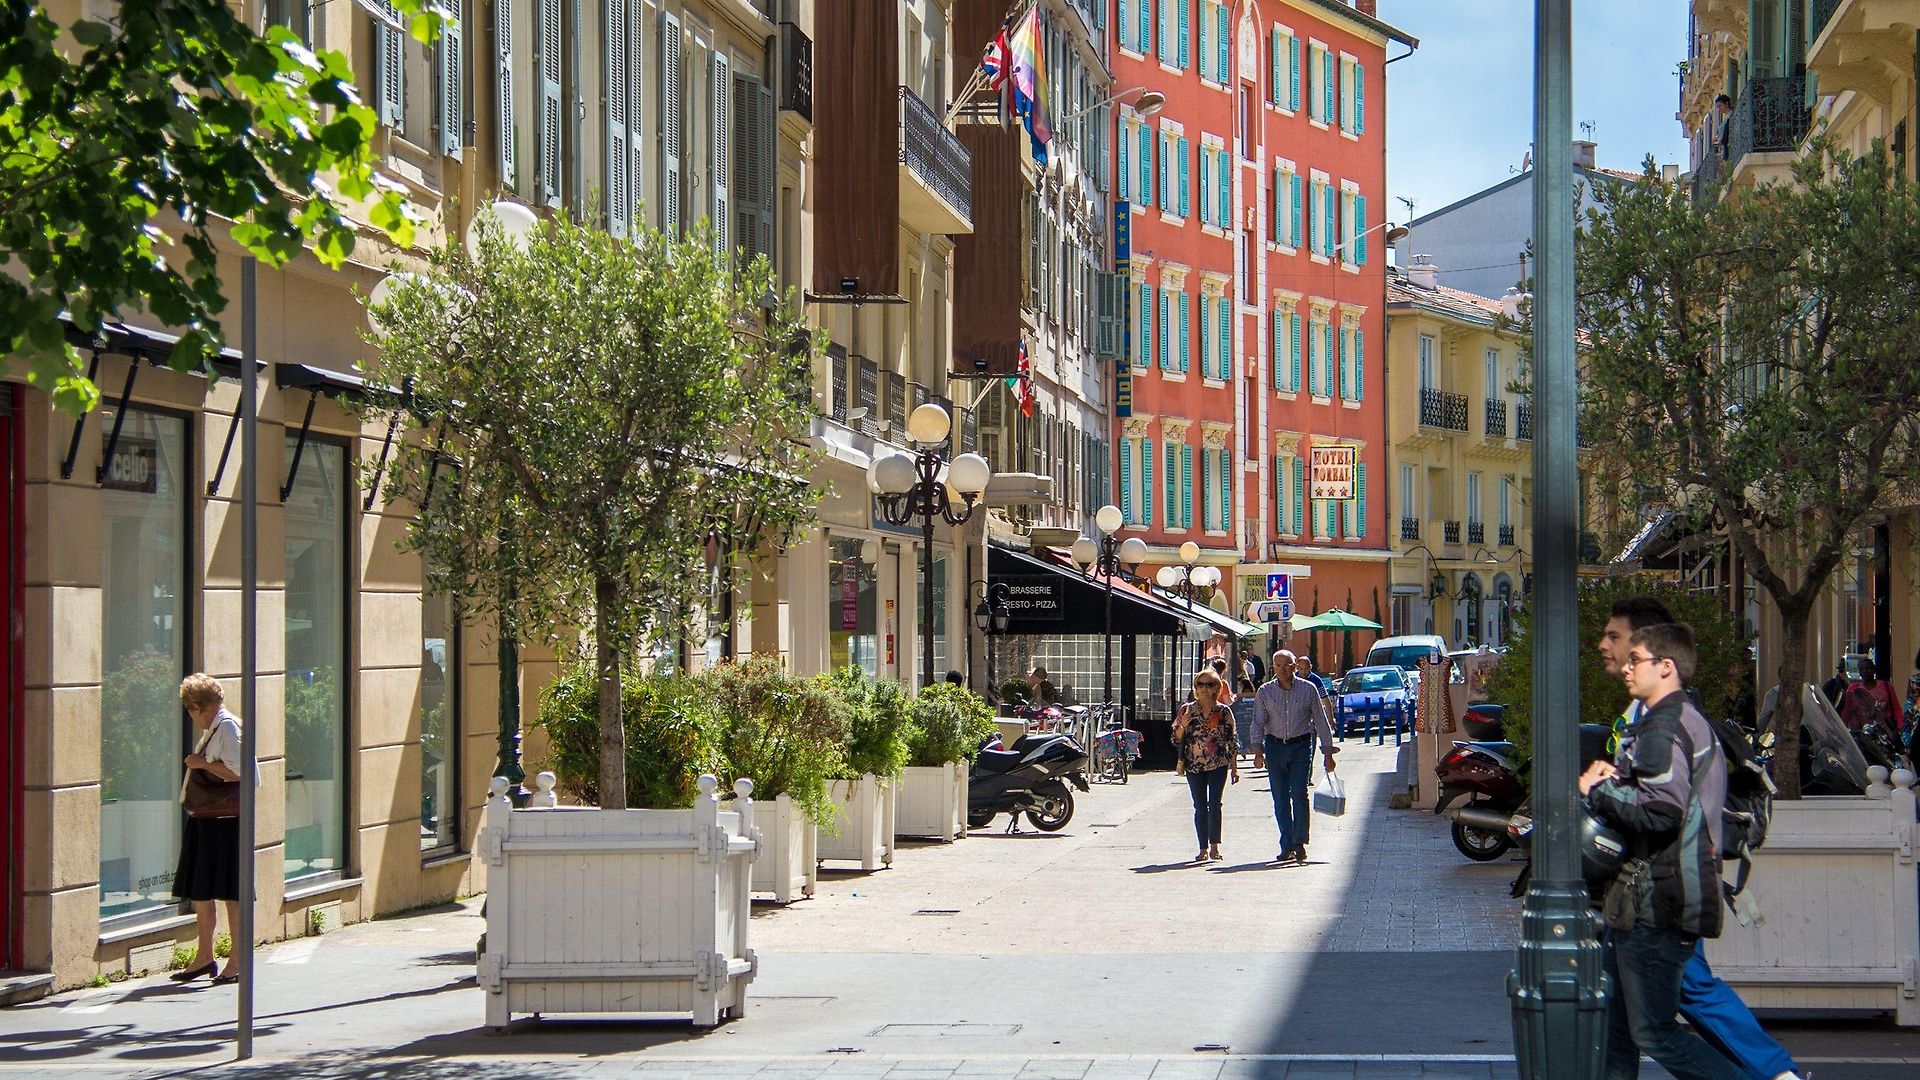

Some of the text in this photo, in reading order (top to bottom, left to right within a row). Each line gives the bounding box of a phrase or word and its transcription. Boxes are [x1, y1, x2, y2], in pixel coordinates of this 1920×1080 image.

[1117, 348, 1131, 406] hote
[112, 445, 148, 483] celio
[1313, 450, 1351, 465] HOTEL
[1313, 467, 1351, 482] BOREAL
[1010, 586, 1052, 595] BRASSERIE
[1005, 600, 1031, 609] RESTO
[1035, 600, 1057, 609] PIZZA
[138, 875, 151, 891] shop
[152, 875, 159, 886] on
